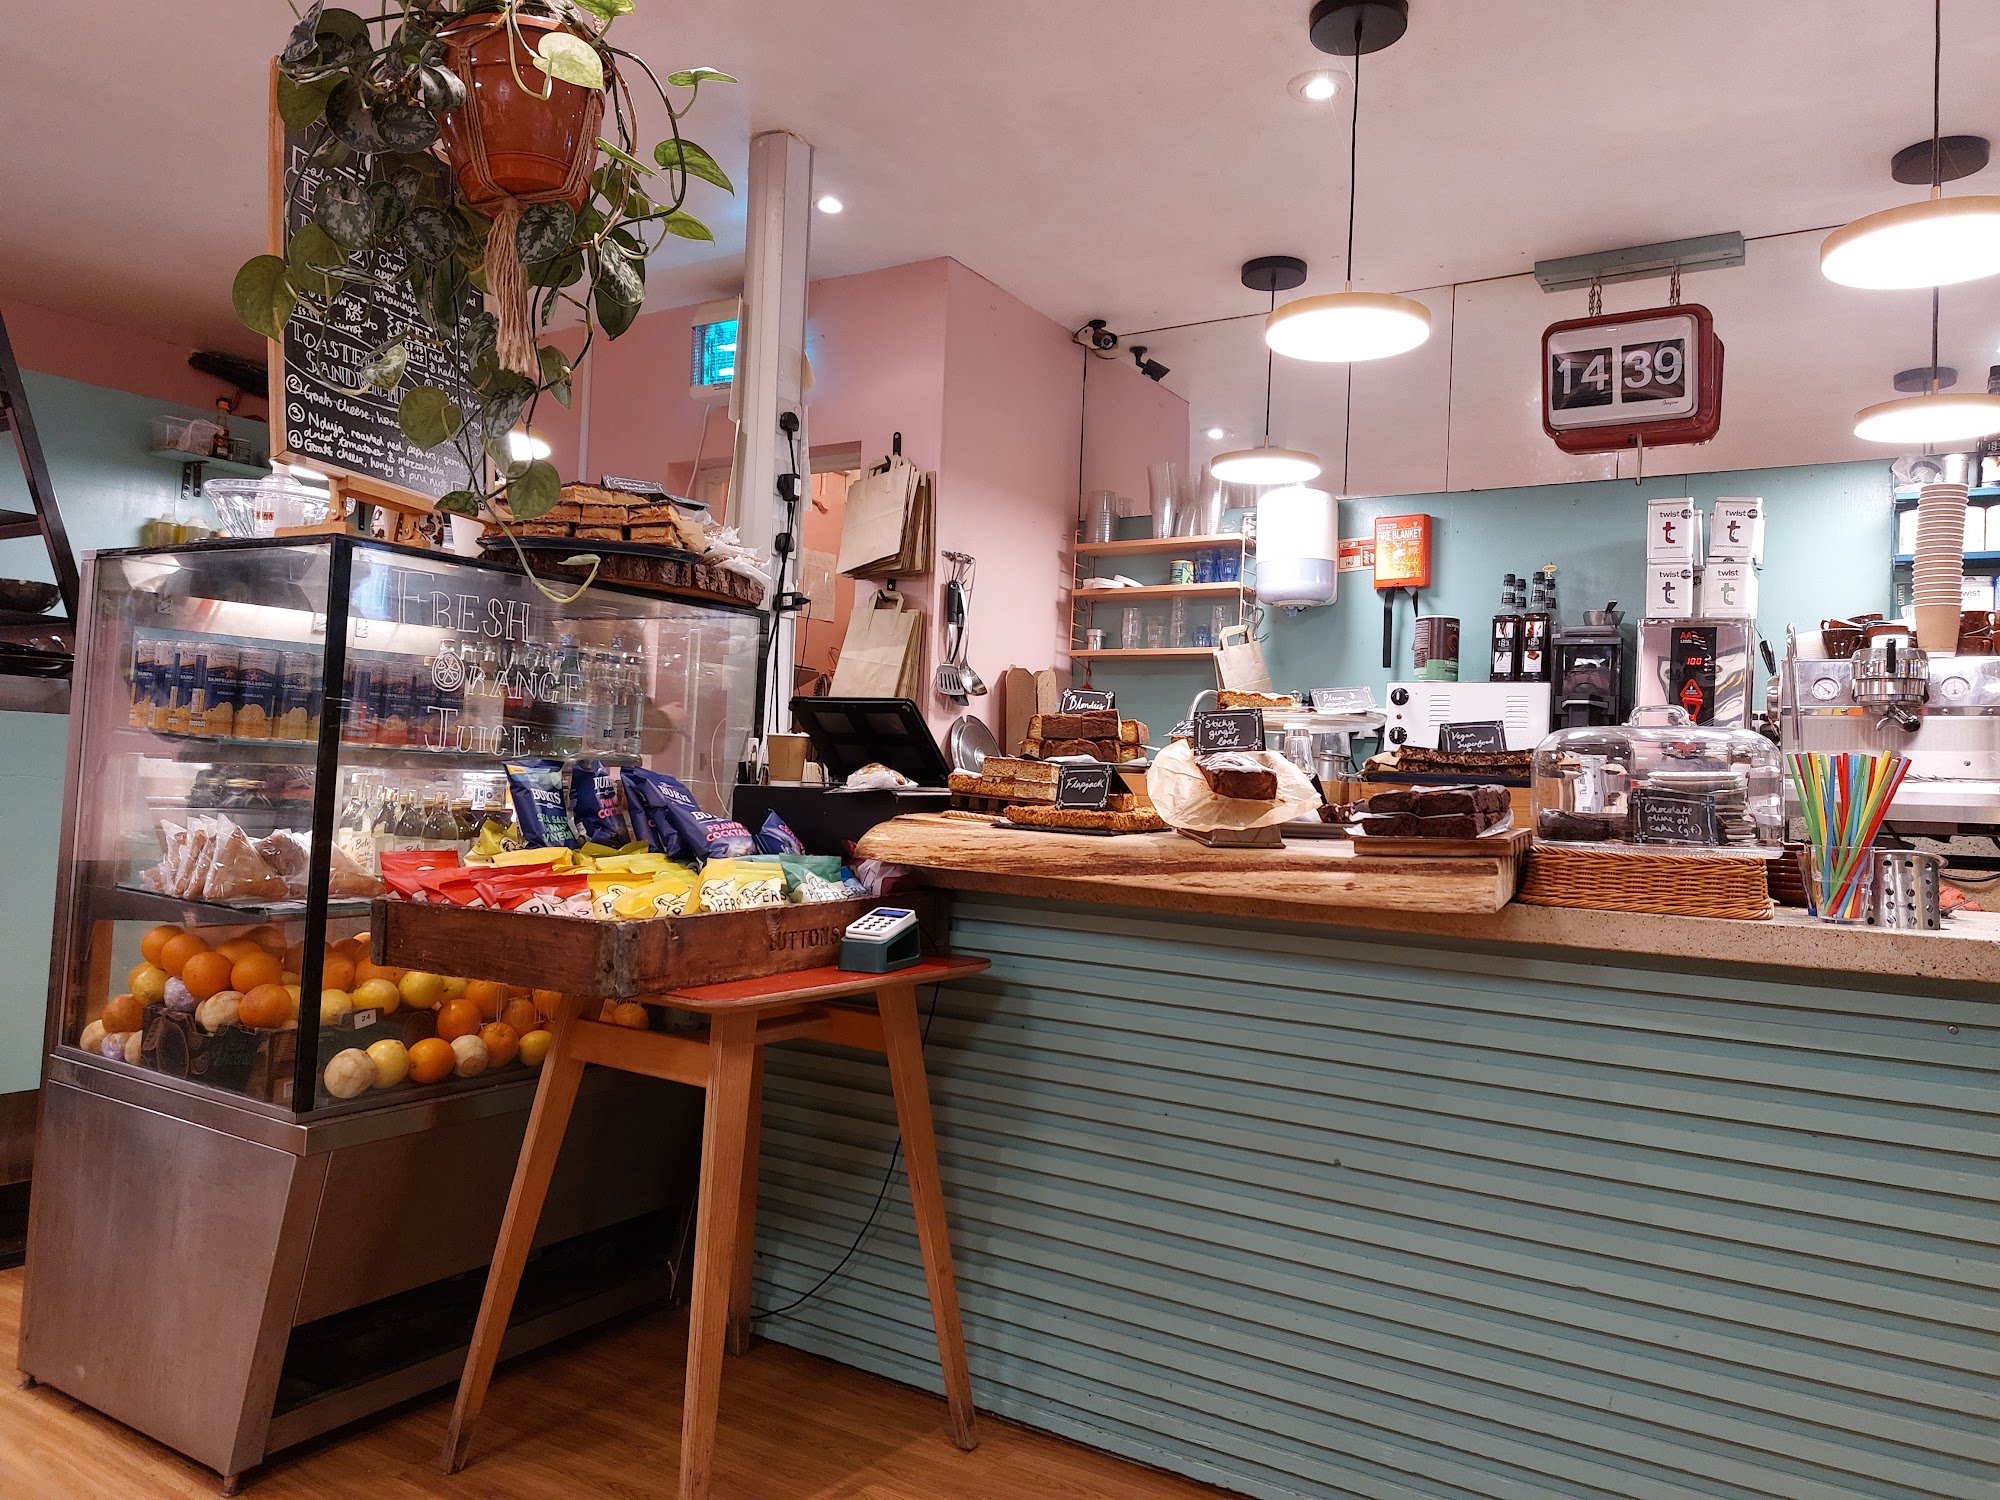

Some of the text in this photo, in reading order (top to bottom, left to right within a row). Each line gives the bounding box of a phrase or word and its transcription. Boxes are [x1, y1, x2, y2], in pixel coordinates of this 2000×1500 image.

[1557, 346, 1682, 394] 14 39
[303, 427, 334, 443] dried
[387, 441, 404, 453] red
[304, 438, 333, 457] Goats
[370, 456, 394, 478] honey
[1660, 510, 1680, 518] twist
[1725, 509, 1746, 517] twist
[1377, 528, 1422, 540] FIRE BLANKET
[1717, 569, 1739, 577] twist
[1962, 589, 1981, 597] wist
[392, 569, 531, 643] FRESH
[1687, 657, 1702, 666] 100
[432, 650, 591, 704] ORANGE
[1067, 694, 1106, 711] Blondies
[1323, 693, 1346, 702] Plum
[425, 706, 531, 758] JUICE
[1205, 719, 1237, 734] Sticky
[1208, 729, 1240, 743] ginger
[1216, 736, 1240, 747] loaf
[1451, 731, 1476, 743] Vegan
[1457, 736, 1495, 750] Superfood
[1064, 777, 1105, 794] Flapjack
[531, 788, 561, 804] BURTS
[1644, 802, 1693, 816] Chocolate
[1647, 813, 1689, 826] olive oil
[706, 822, 743, 833] PRAWN
[1649, 824, 1676, 833] cake
[542, 832, 573, 843] VINEGA
[706, 830, 751, 842] COCKTAIL
[361, 1014, 371, 1022] 24
